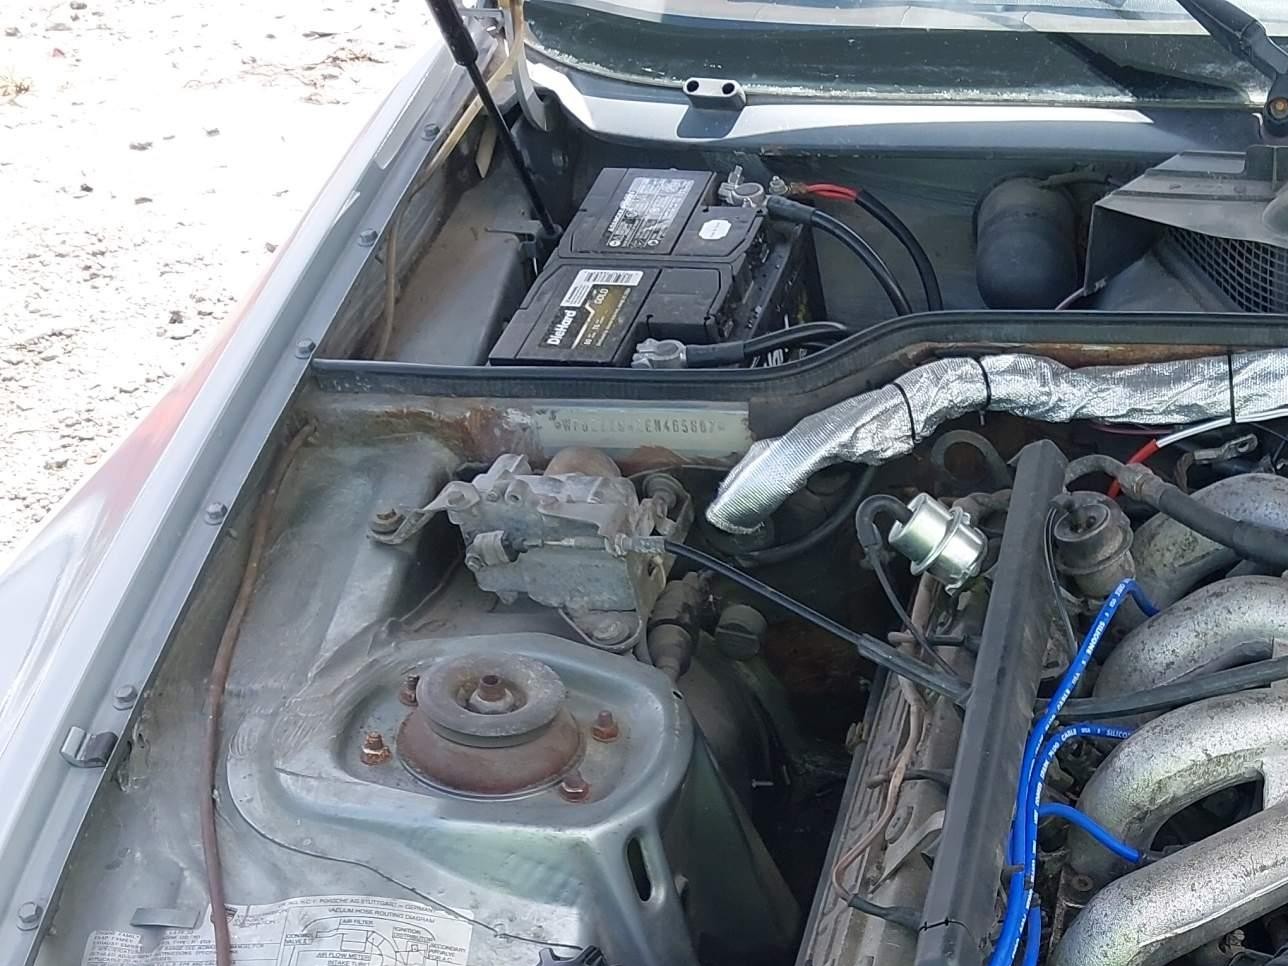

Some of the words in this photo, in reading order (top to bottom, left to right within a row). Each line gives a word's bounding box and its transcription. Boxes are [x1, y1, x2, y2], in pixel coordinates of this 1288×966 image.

[594, 288, 609, 305] GOLD
[547, 309, 577, 345] DieHard
[1086, 620, 1105, 656] SILICONE
[1061, 728, 1077, 742] CABLE
[374, 910, 403, 919] ROUTING
[405, 913, 435, 924] DIAGRAM
